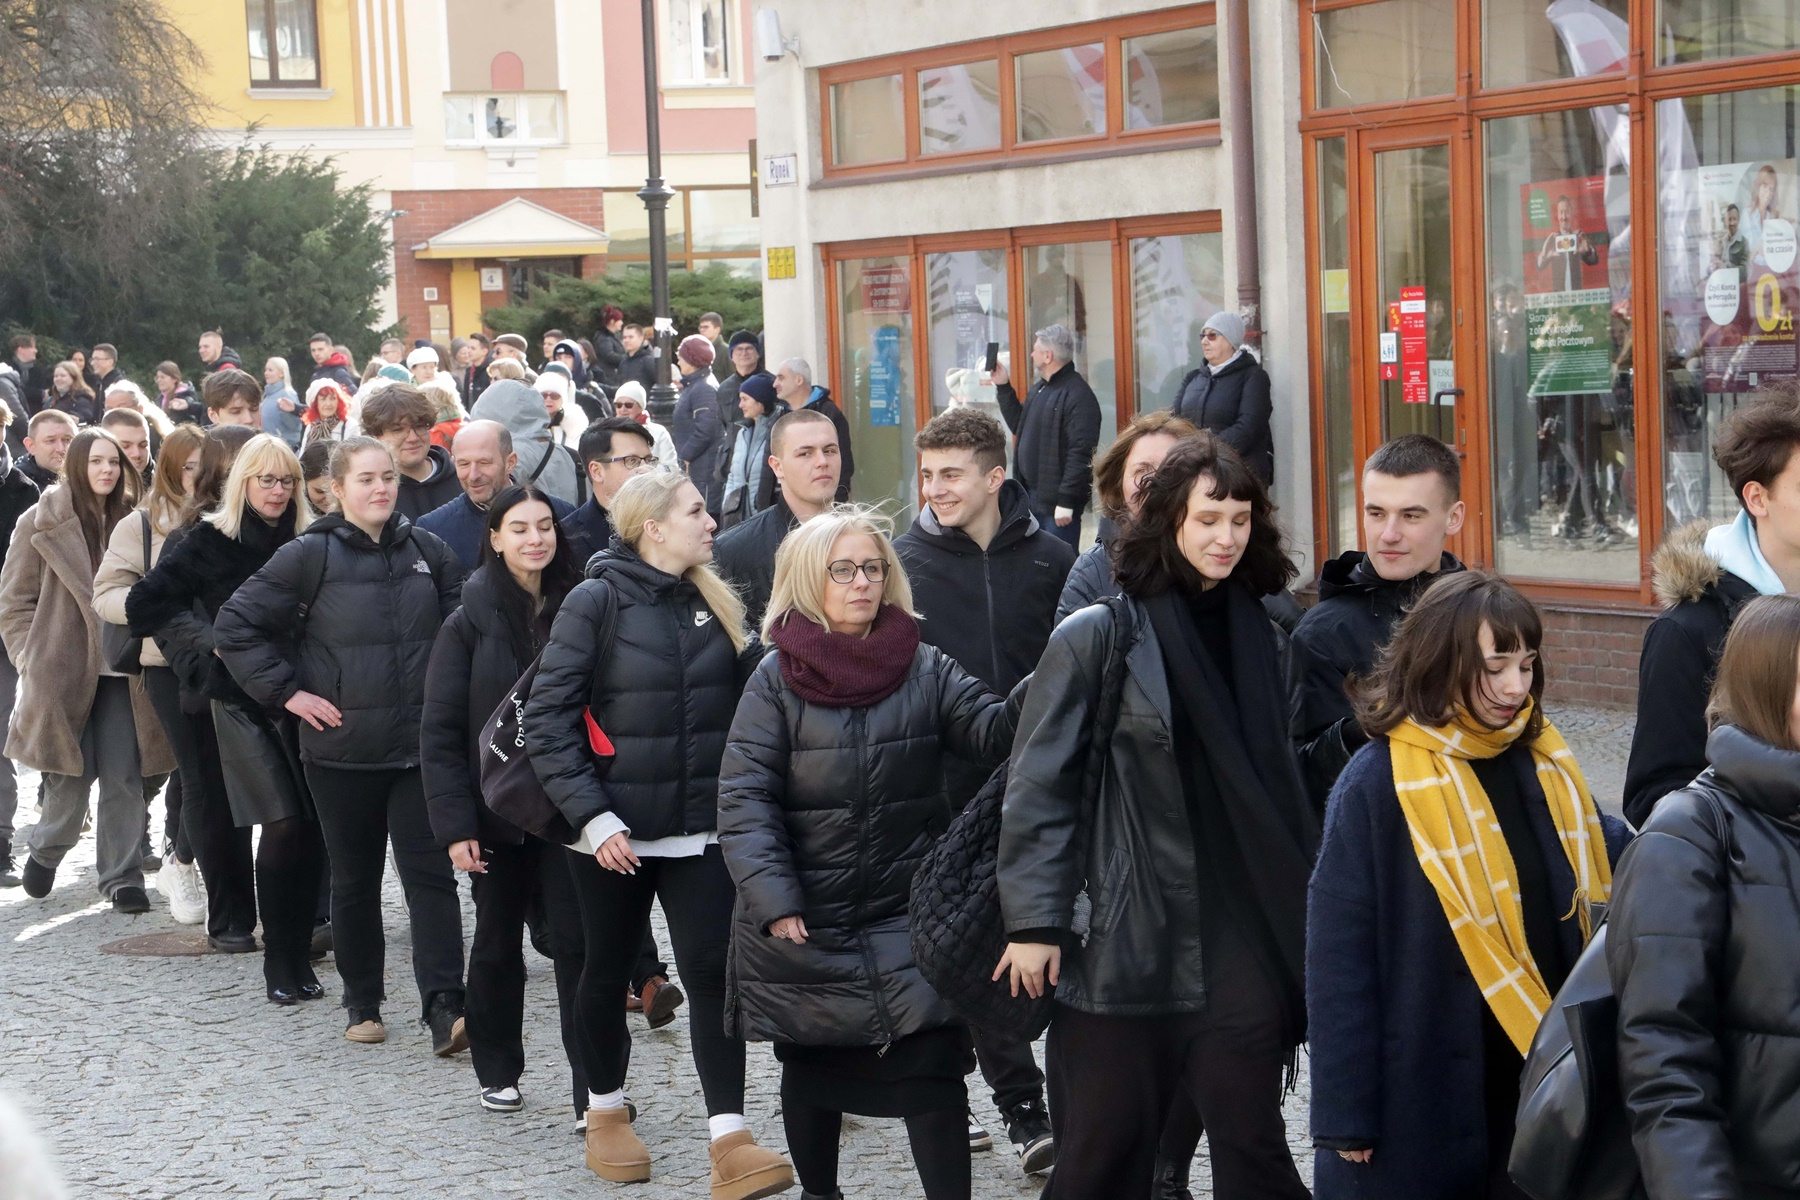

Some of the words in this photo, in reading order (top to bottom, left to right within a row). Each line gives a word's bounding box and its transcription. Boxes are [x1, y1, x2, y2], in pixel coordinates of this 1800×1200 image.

[770, 160, 789, 183] Rynek
[1755, 273, 1780, 332] 0
[1780, 310, 1793, 331] zł
[1557, 336, 1594, 347] Pocztowym
